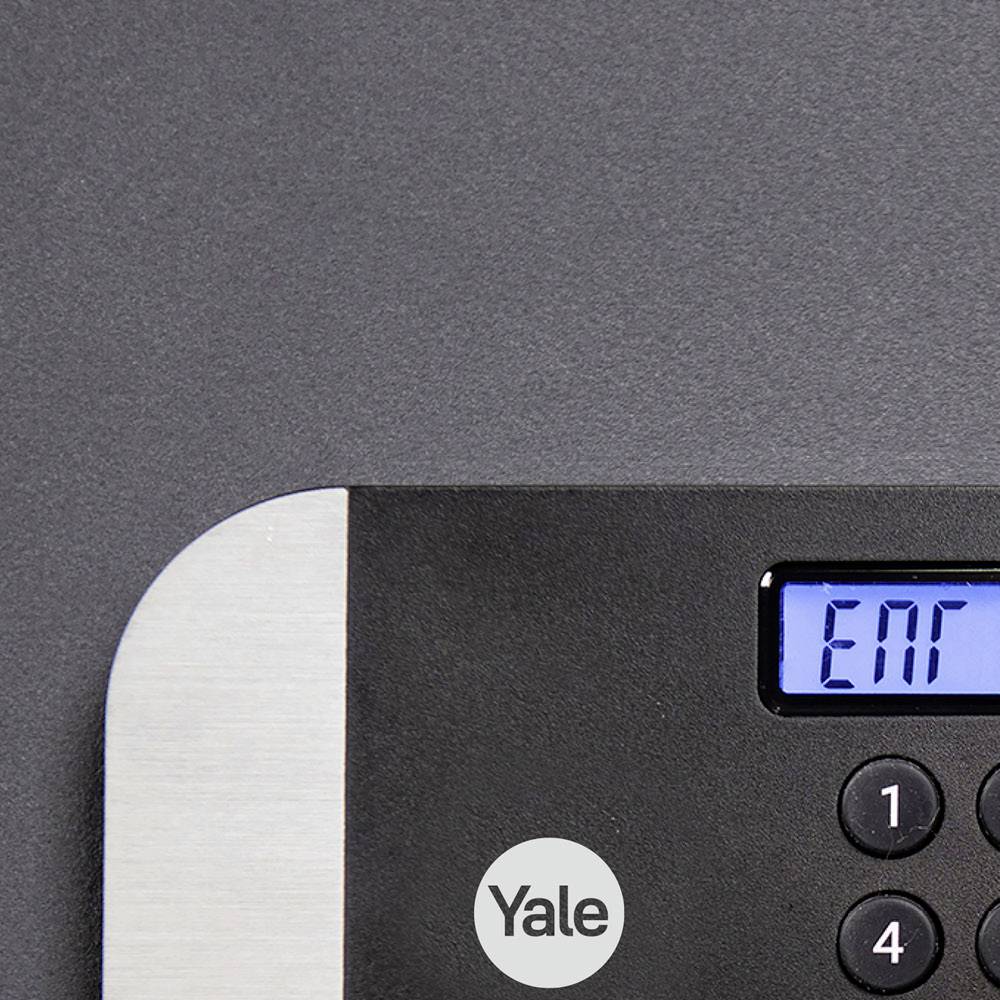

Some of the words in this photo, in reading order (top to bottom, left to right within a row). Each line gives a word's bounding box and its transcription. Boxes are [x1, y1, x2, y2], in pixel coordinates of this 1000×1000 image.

[881, 784, 899, 828] 1
[488, 885, 609, 937] Yale
[872, 921, 904, 964] 4
